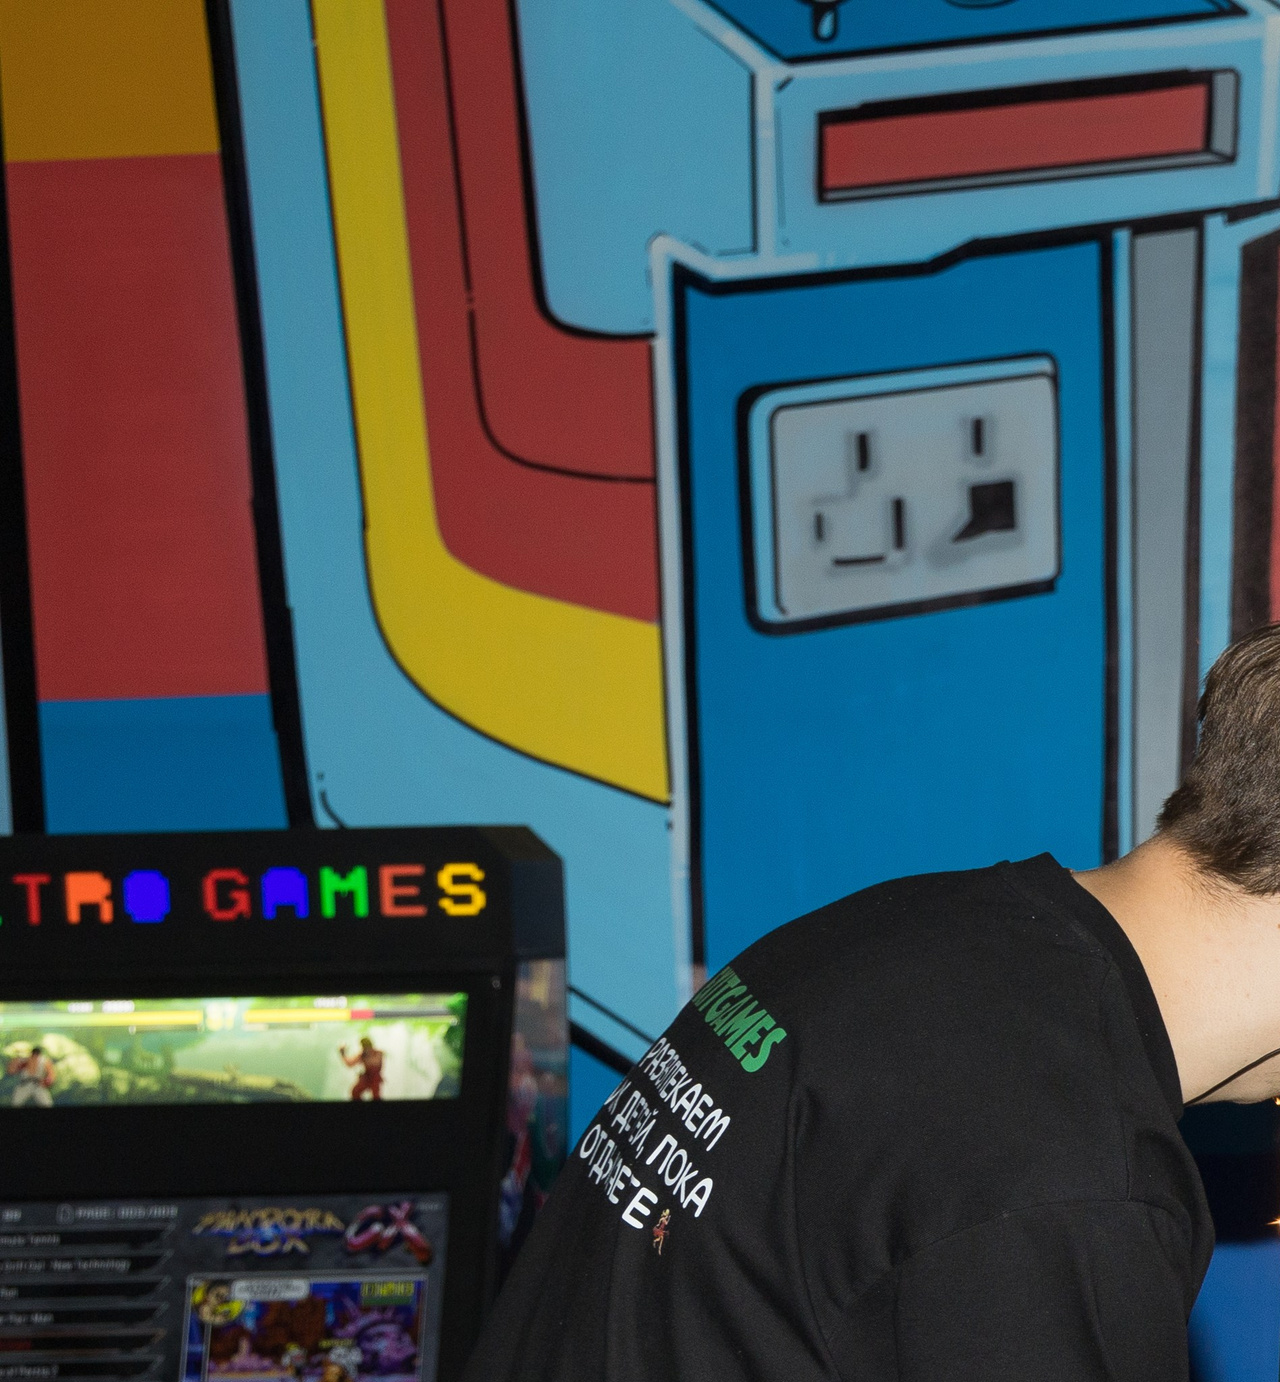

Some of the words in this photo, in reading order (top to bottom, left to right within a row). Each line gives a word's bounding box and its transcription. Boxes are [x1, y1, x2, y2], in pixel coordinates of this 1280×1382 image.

[12, 869, 170, 925] TRO
[202, 862, 487, 921] GAMES
[645, 1134, 713, 1218] ПОКА
